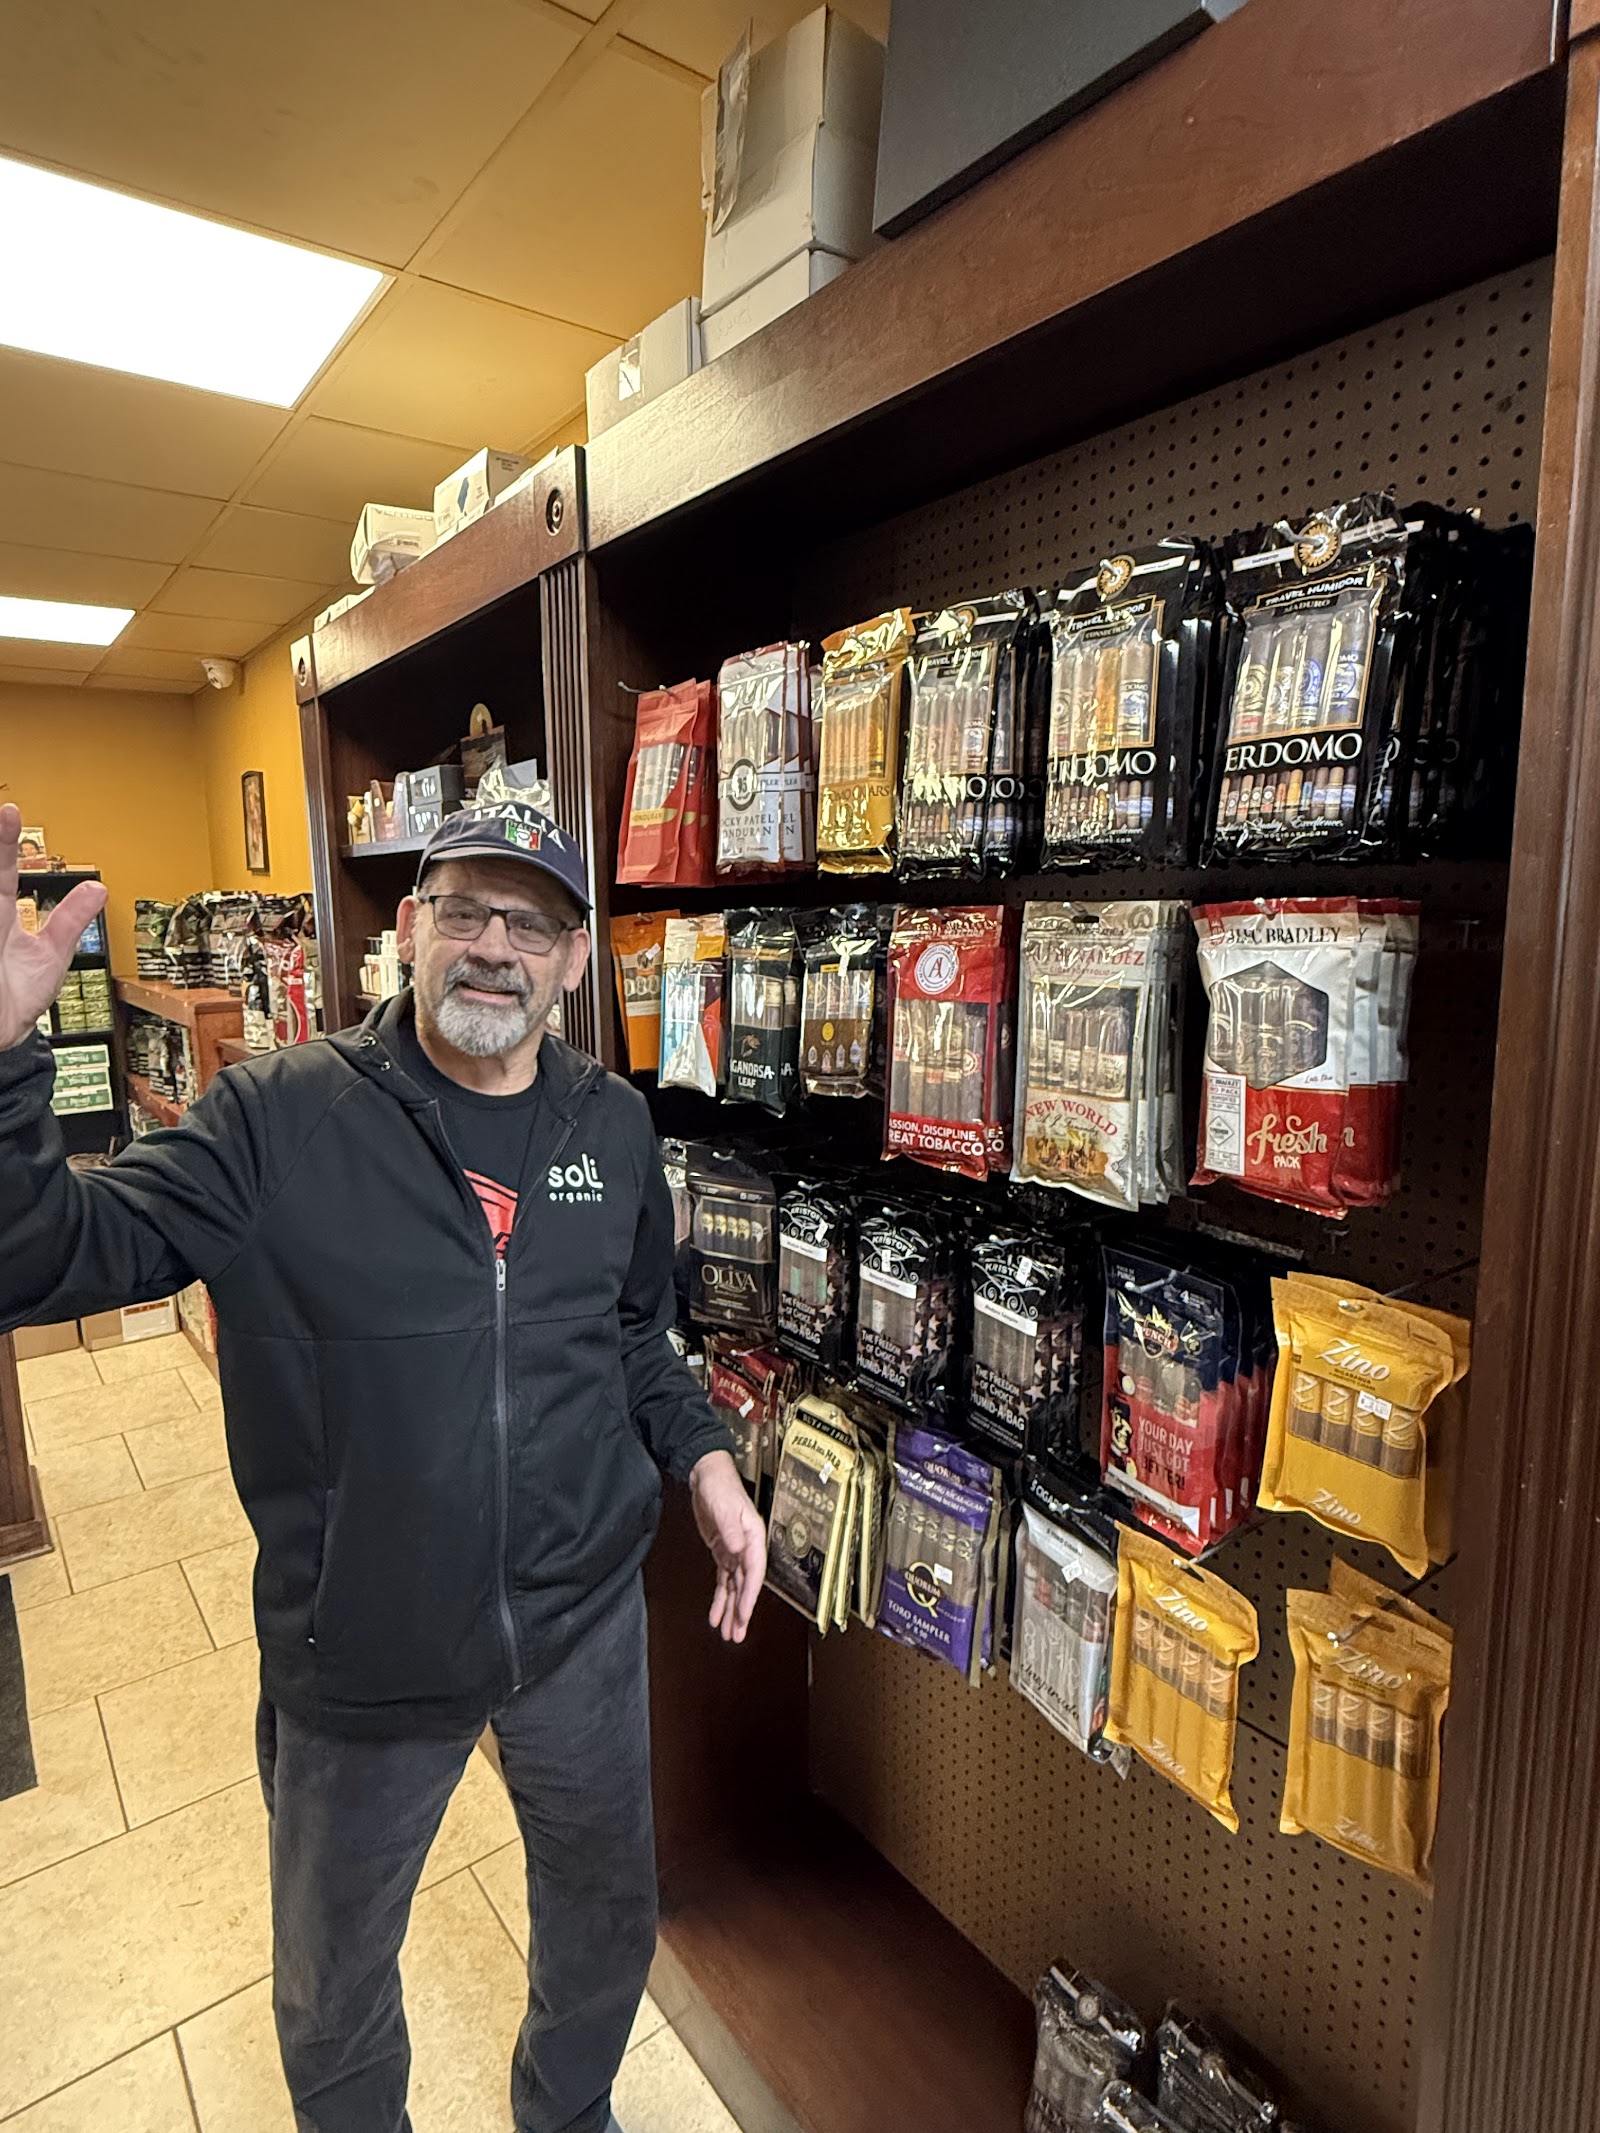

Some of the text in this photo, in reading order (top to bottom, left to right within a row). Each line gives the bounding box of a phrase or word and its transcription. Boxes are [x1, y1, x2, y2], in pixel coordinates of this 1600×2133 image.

[1265, 576, 1365, 607] TRAVEL HUMIDOR
[473, 804, 567, 853] ITALIA
[744, 813, 775, 825] PATEL
[1265, 925, 1341, 945] BRADLEY
[738, 1076, 757, 1089] LEAF
[922, 1124, 980, 1142] DISCIPLINE,
[1026, 1099, 1119, 1137] NEW WORLD
[918, 1134, 985, 1157] TOBACCO
[1247, 1113, 1328, 1166] fresh
[548, 1153, 604, 1189] soli
[1273, 1155, 1301, 1169] PACK
[549, 1189, 603, 1203] organic
[1315, 1337, 1391, 1381] Zino
[988, 1370, 1021, 1398] FREEDOM
[791, 1436, 817, 1451] PERLA
[825, 1448, 842, 1471] MAR
[1138, 1416, 1194, 1456] YOUR DAY
[1138, 1433, 1190, 1473] JUST GOT
[1309, 1486, 1362, 1526] Zino
[904, 1571, 942, 1597] QUORUM
[887, 1599, 912, 1620] TORO
[911, 1614, 951, 1645] SAMPLER
[1154, 1585, 1209, 1632] Zino
[1329, 1643, 1404, 1690] Zino
